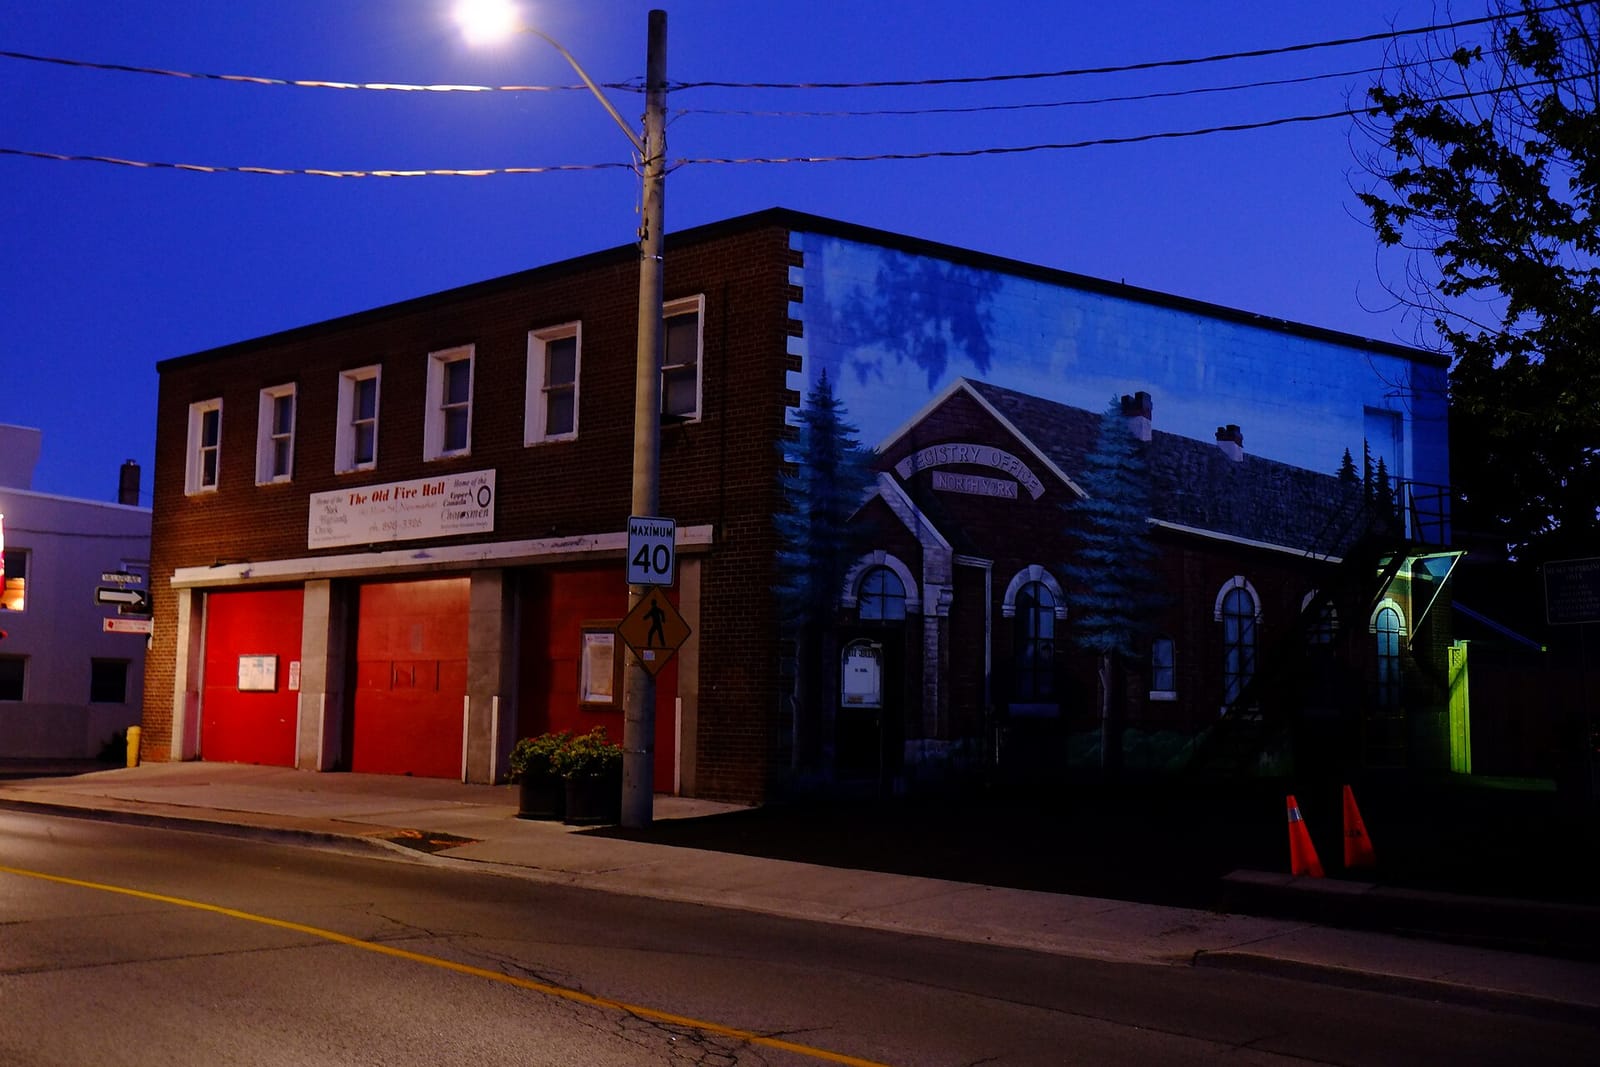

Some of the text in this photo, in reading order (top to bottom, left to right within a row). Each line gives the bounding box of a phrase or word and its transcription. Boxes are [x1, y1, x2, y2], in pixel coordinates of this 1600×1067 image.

[903, 445, 1039, 492] REGISTRY OFFICE
[349, 481, 446, 506] The Old Fire Hall
[938, 474, 1016, 497] NORTH YORK
[630, 524, 673, 538] MAXIMUM
[632, 543, 671, 575] 40
